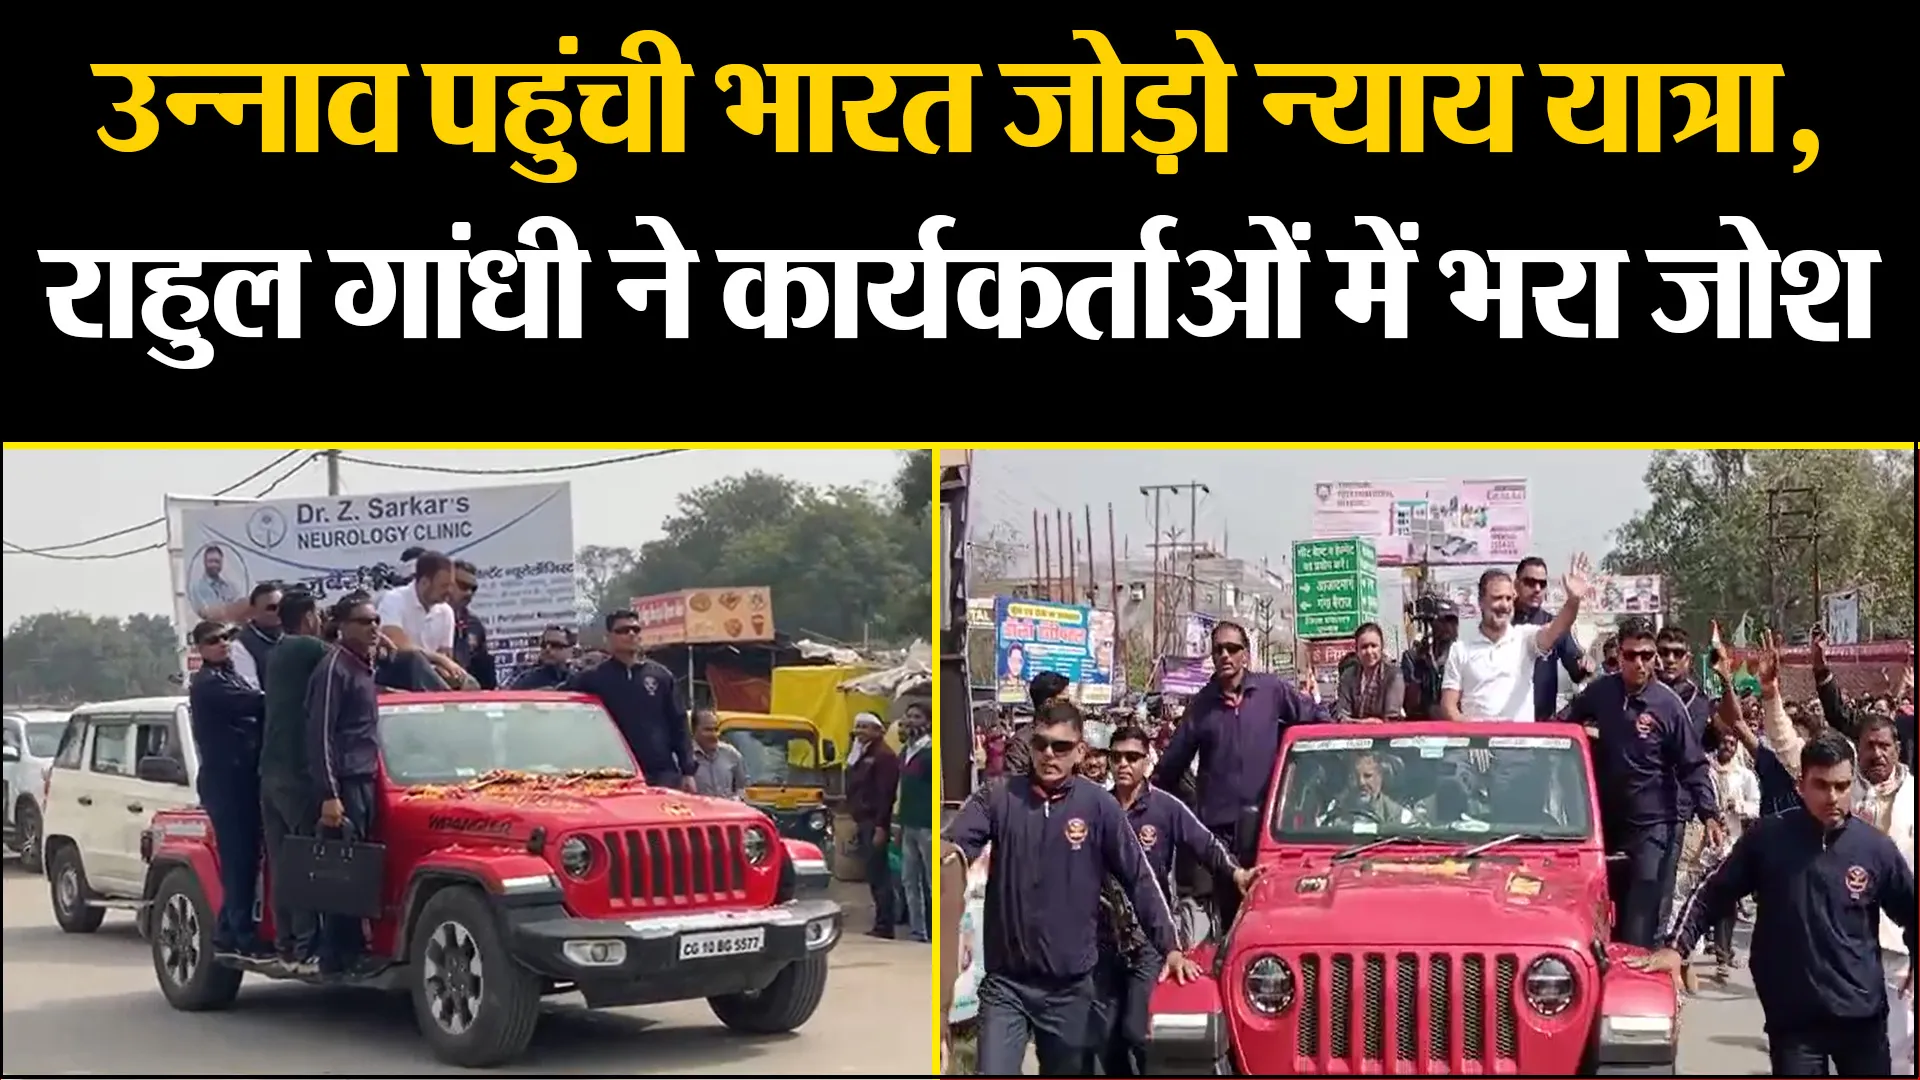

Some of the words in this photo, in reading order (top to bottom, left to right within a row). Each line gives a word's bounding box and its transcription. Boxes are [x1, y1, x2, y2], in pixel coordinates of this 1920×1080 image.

[297, 503, 329, 524] Dr.
[337, 500, 360, 522] Z.
[368, 496, 470, 519] Sarkar's
[297, 526, 408, 549] NEUROLOGY
[414, 521, 472, 541] CLINIC
[684, 942, 699, 956] CG
[702, 940, 715, 953] 10
[717, 938, 732, 952] BG
[733, 936, 760, 951] 5577
